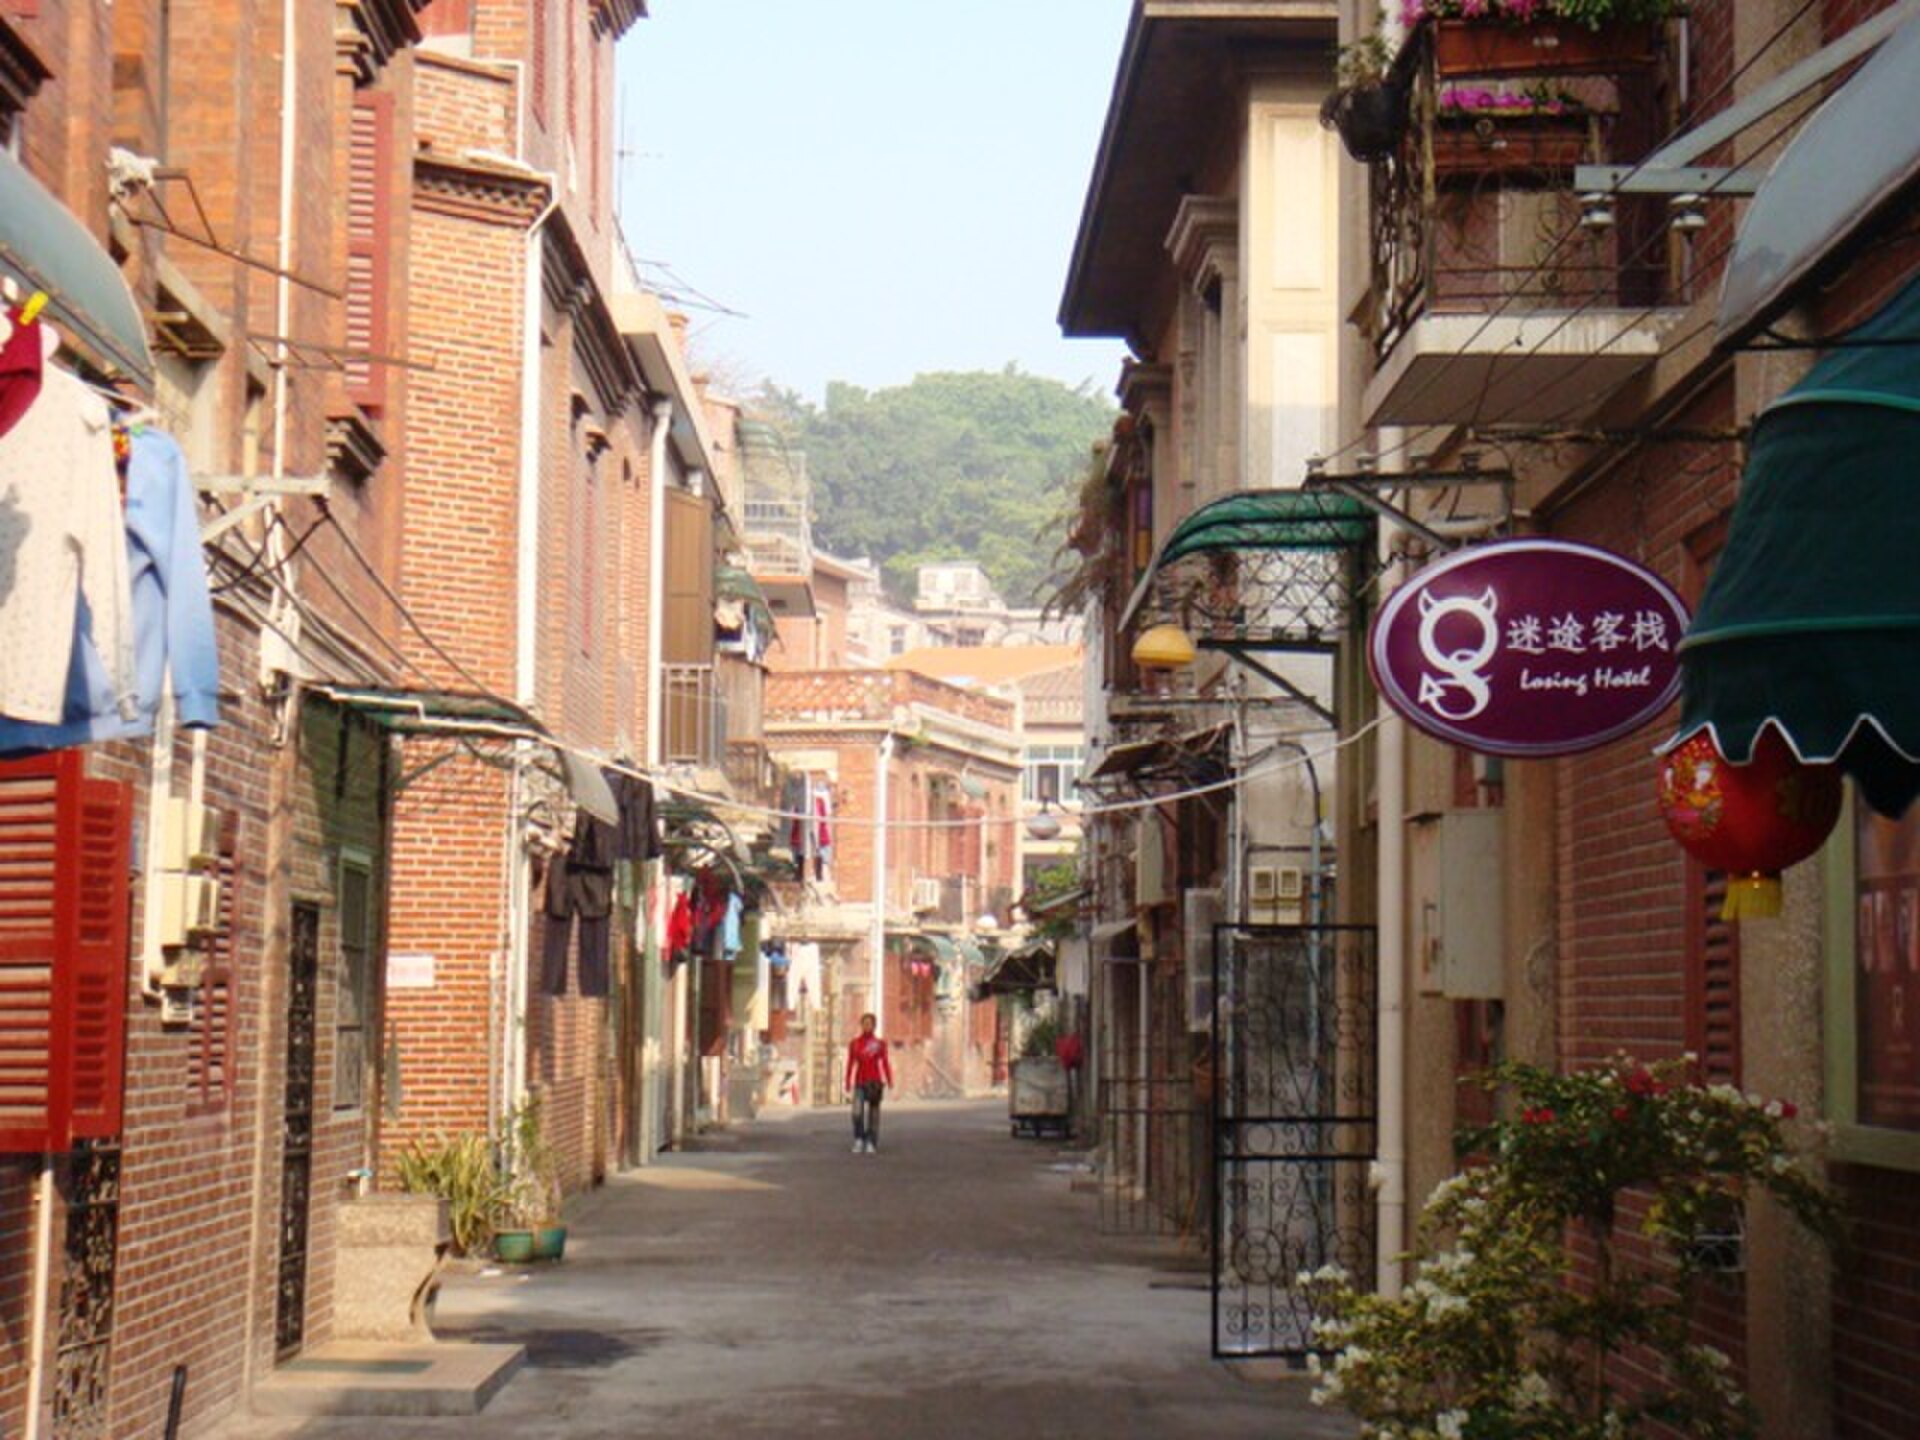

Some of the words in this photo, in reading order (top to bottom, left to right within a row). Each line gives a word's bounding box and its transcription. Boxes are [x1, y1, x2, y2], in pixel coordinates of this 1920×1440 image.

[1506, 611, 1669, 654] 迷途客栈
[1520, 668, 1587, 696] Losing
[1594, 665, 1651, 689] Hotel
